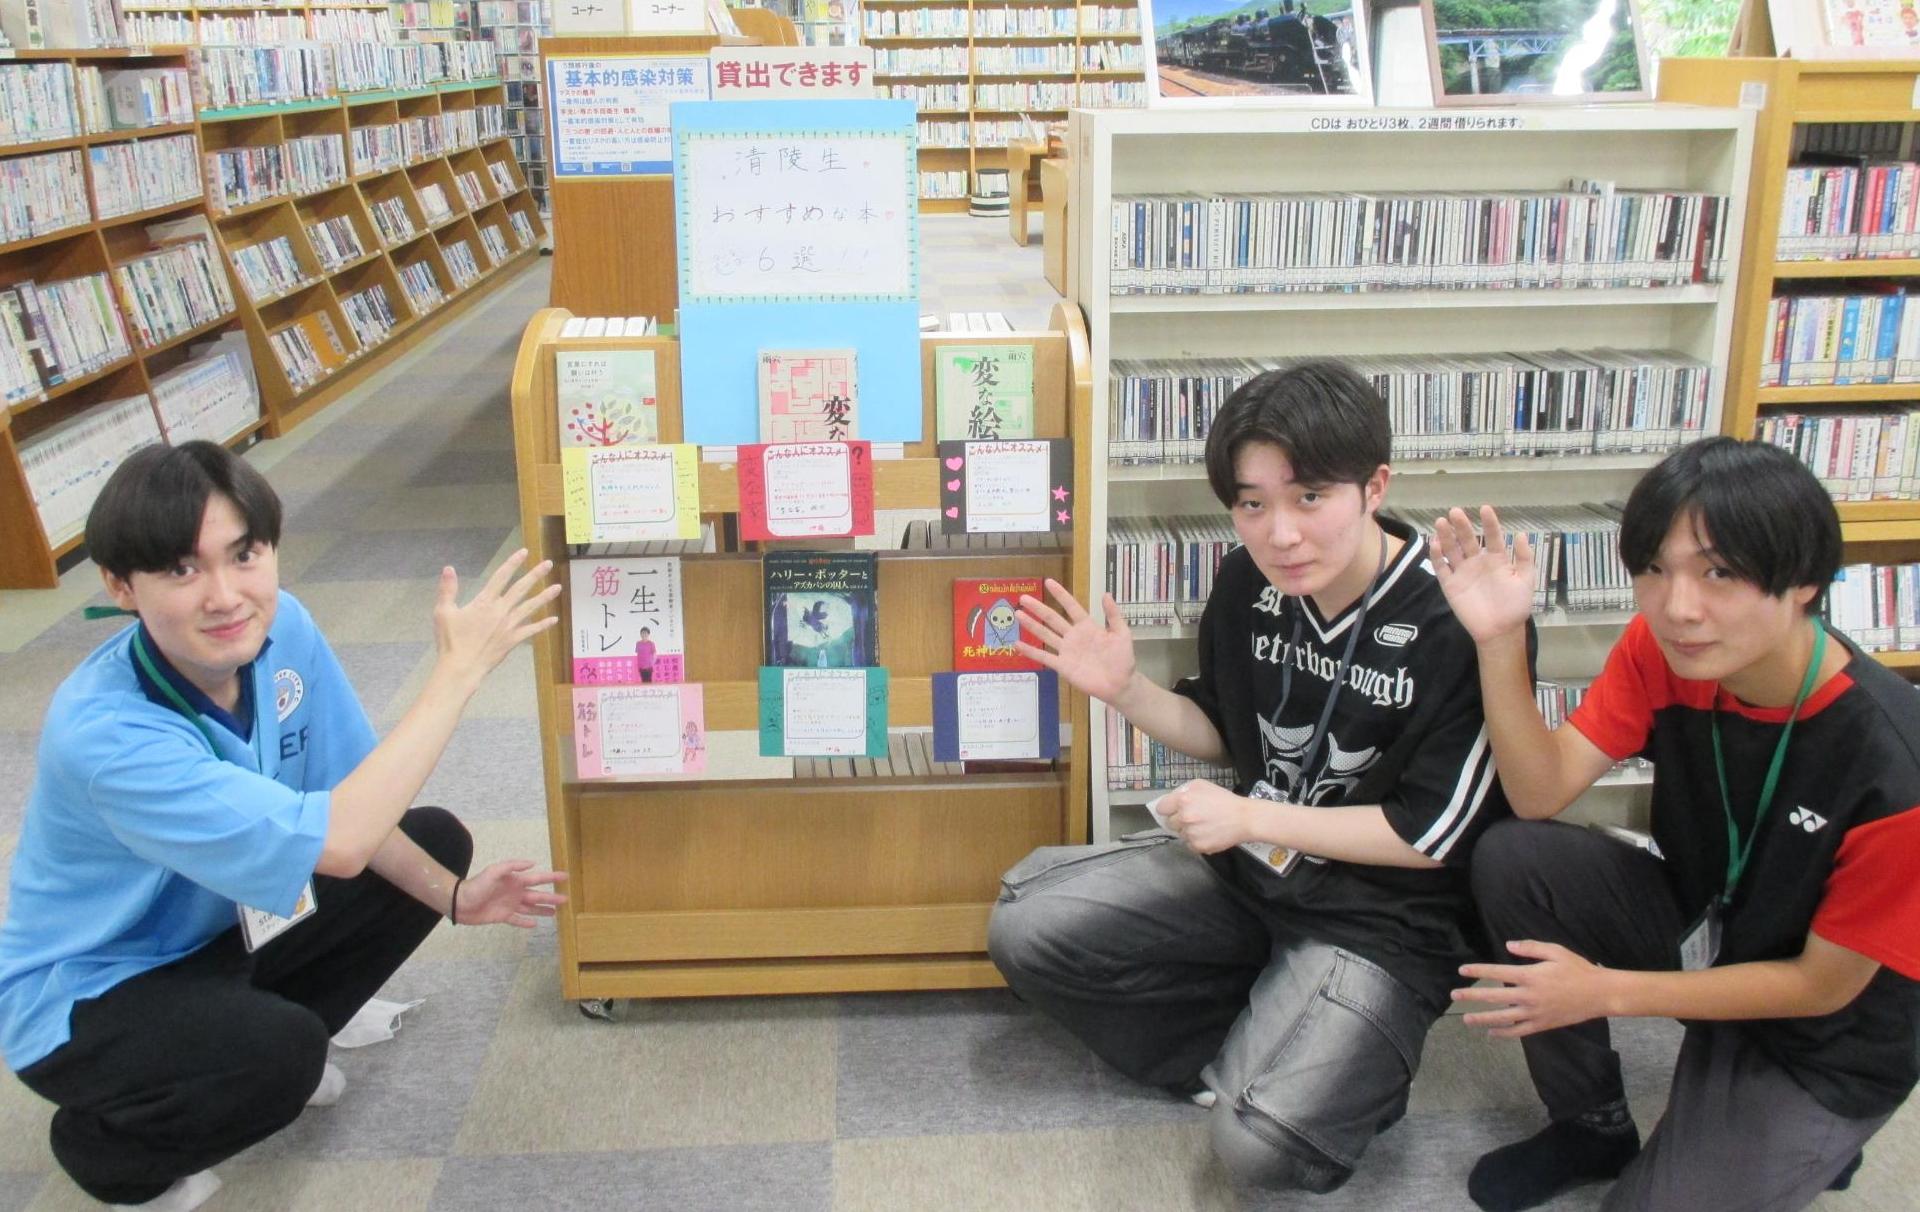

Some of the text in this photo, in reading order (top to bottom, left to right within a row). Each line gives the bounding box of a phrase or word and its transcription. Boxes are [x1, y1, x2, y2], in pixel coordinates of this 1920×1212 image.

[571, 4, 604, 16] コーナー
[651, 3, 685, 14] コーナー
[565, 67, 694, 88] 基本的感染対策
[716, 60, 868, 88] 貸出できます
[735, 146, 847, 176] 清陵生
[712, 200, 879, 224] おすすめな本
[1008, 349, 1027, 361] 雨穴
[967, 356, 1003, 440] 変な絵
[823, 395, 852, 441] 変な
[592, 449, 669, 464] こんな人にオススメ
[769, 568, 869, 580] ハリー・ポッターと
[793, 580, 850, 590] アズカバンの囚人
[627, 567, 660, 626] 一生、
[591, 565, 622, 653] 筋トレ
[1252, 632, 1415, 710] etrboough
